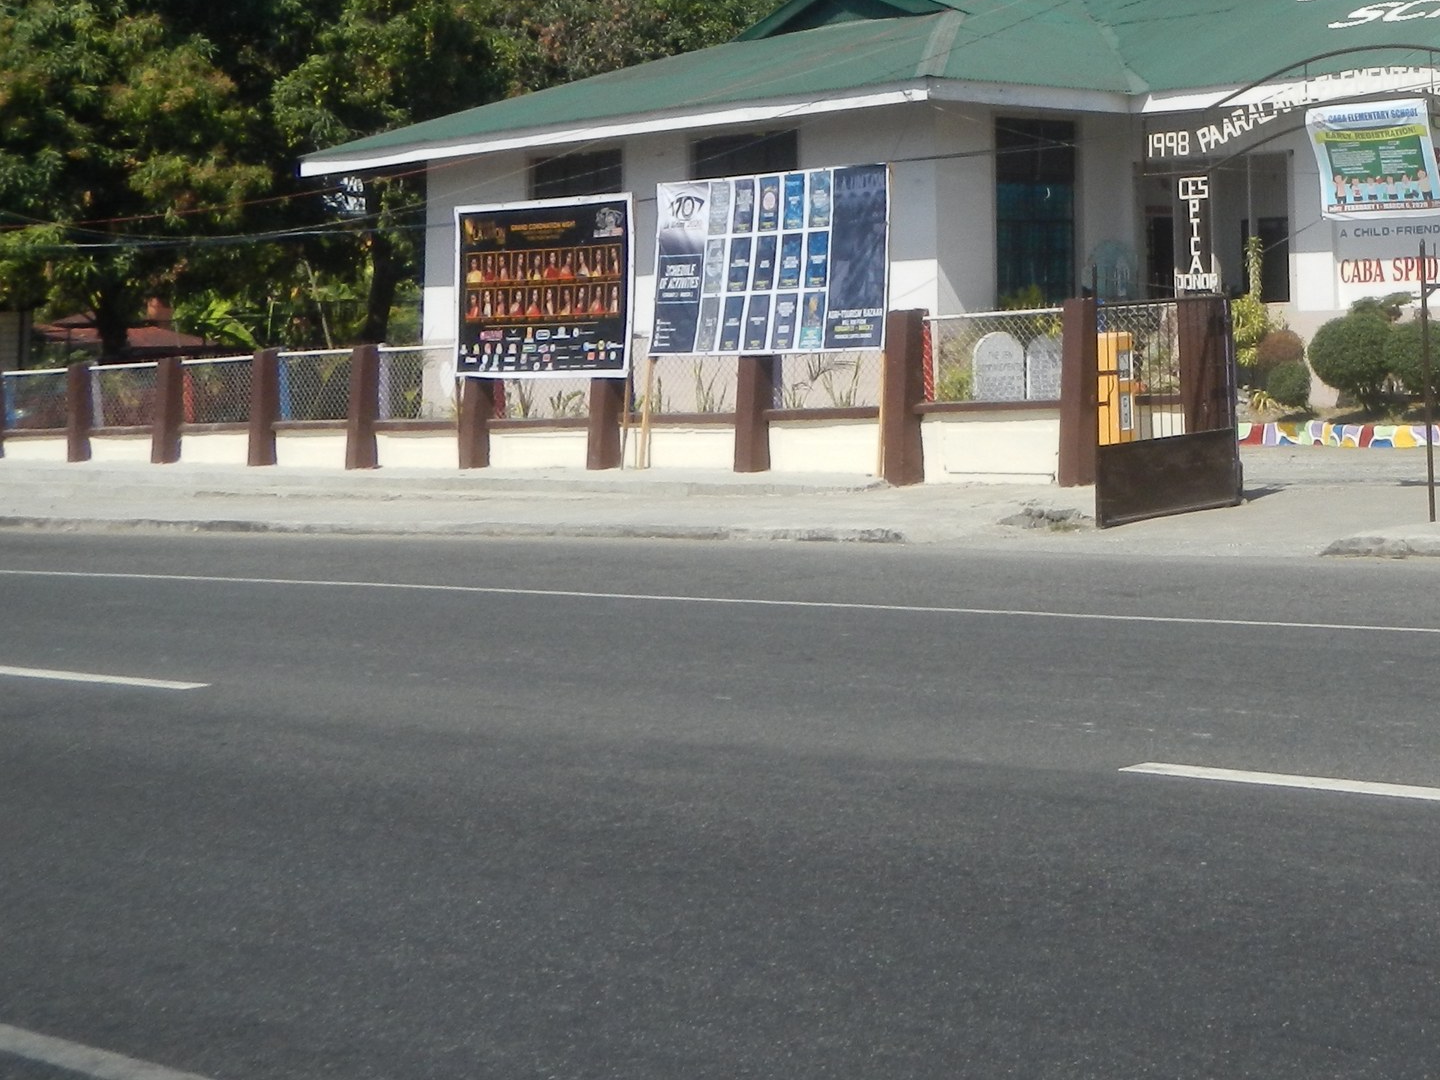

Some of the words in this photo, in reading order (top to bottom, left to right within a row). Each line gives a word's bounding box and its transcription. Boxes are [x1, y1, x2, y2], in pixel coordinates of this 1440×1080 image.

[1348, 109, 1390, 122] ELEMENTARY
[1391, 108, 1418, 119] SCHOOL
[1326, 131, 1352, 140] EARLY
[1148, 130, 1190, 157] 1998
[1340, 228, 1348, 238] A
[1340, 257, 1385, 283] CABA
